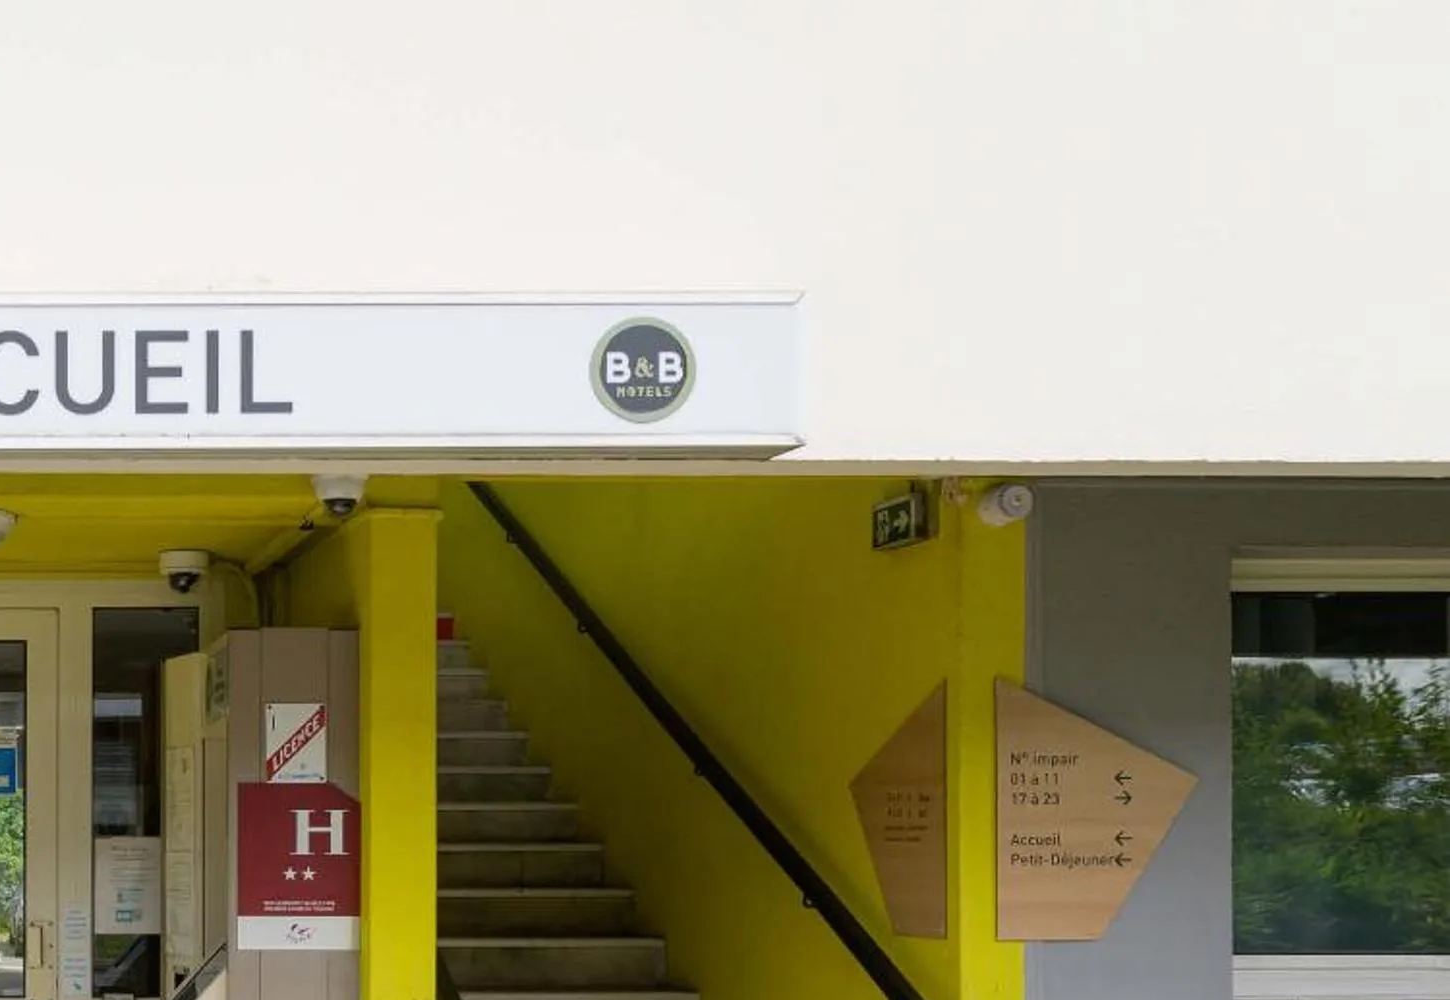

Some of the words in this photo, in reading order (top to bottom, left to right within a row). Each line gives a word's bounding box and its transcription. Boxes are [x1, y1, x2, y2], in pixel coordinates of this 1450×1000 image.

[606, 351, 684, 384] B&B
[616, 386, 672, 398] HOTELS
[271, 711, 326, 772] LICENCE
[1033, 751, 1080, 768] impair
[1010, 773, 1026, 785] 01
[1044, 773, 1059, 785] 11
[1011, 793, 1026, 806] 17
[1043, 793, 1060, 805] 23
[289, 809, 351, 856] H
[1010, 833, 1061, 846] Accueil
[1010, 853, 1115, 869] Petit-Déjeuner
